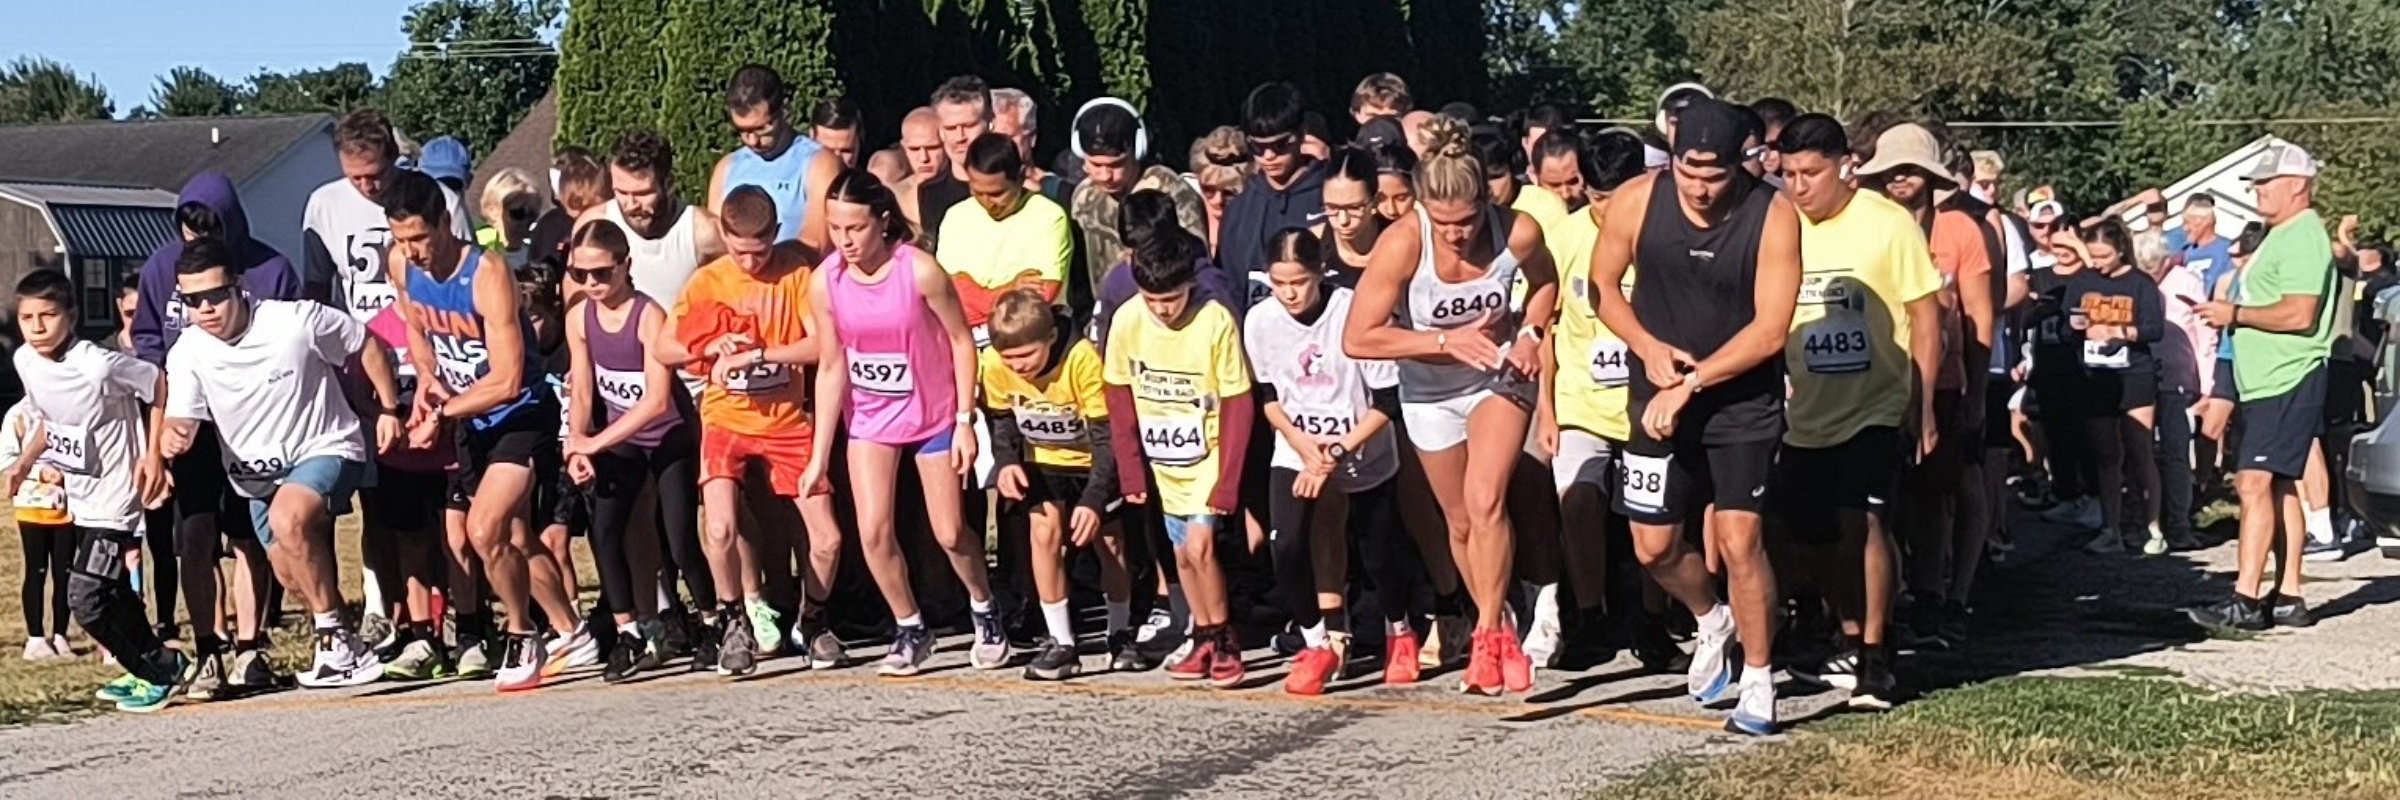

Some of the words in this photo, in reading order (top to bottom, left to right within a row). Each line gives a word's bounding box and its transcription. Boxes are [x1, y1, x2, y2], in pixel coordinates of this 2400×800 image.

[1432, 291, 1502, 319] 6840
[1804, 330, 1866, 355] 4483
[1592, 350, 1628, 368] 44
[850, 360, 908, 382] 4597
[598, 375, 643, 402] 4469
[1020, 418, 1083, 434] 4485
[1292, 413, 1351, 435] 4521
[1144, 426, 1201, 448] 4464
[228, 457, 283, 476] 4529
